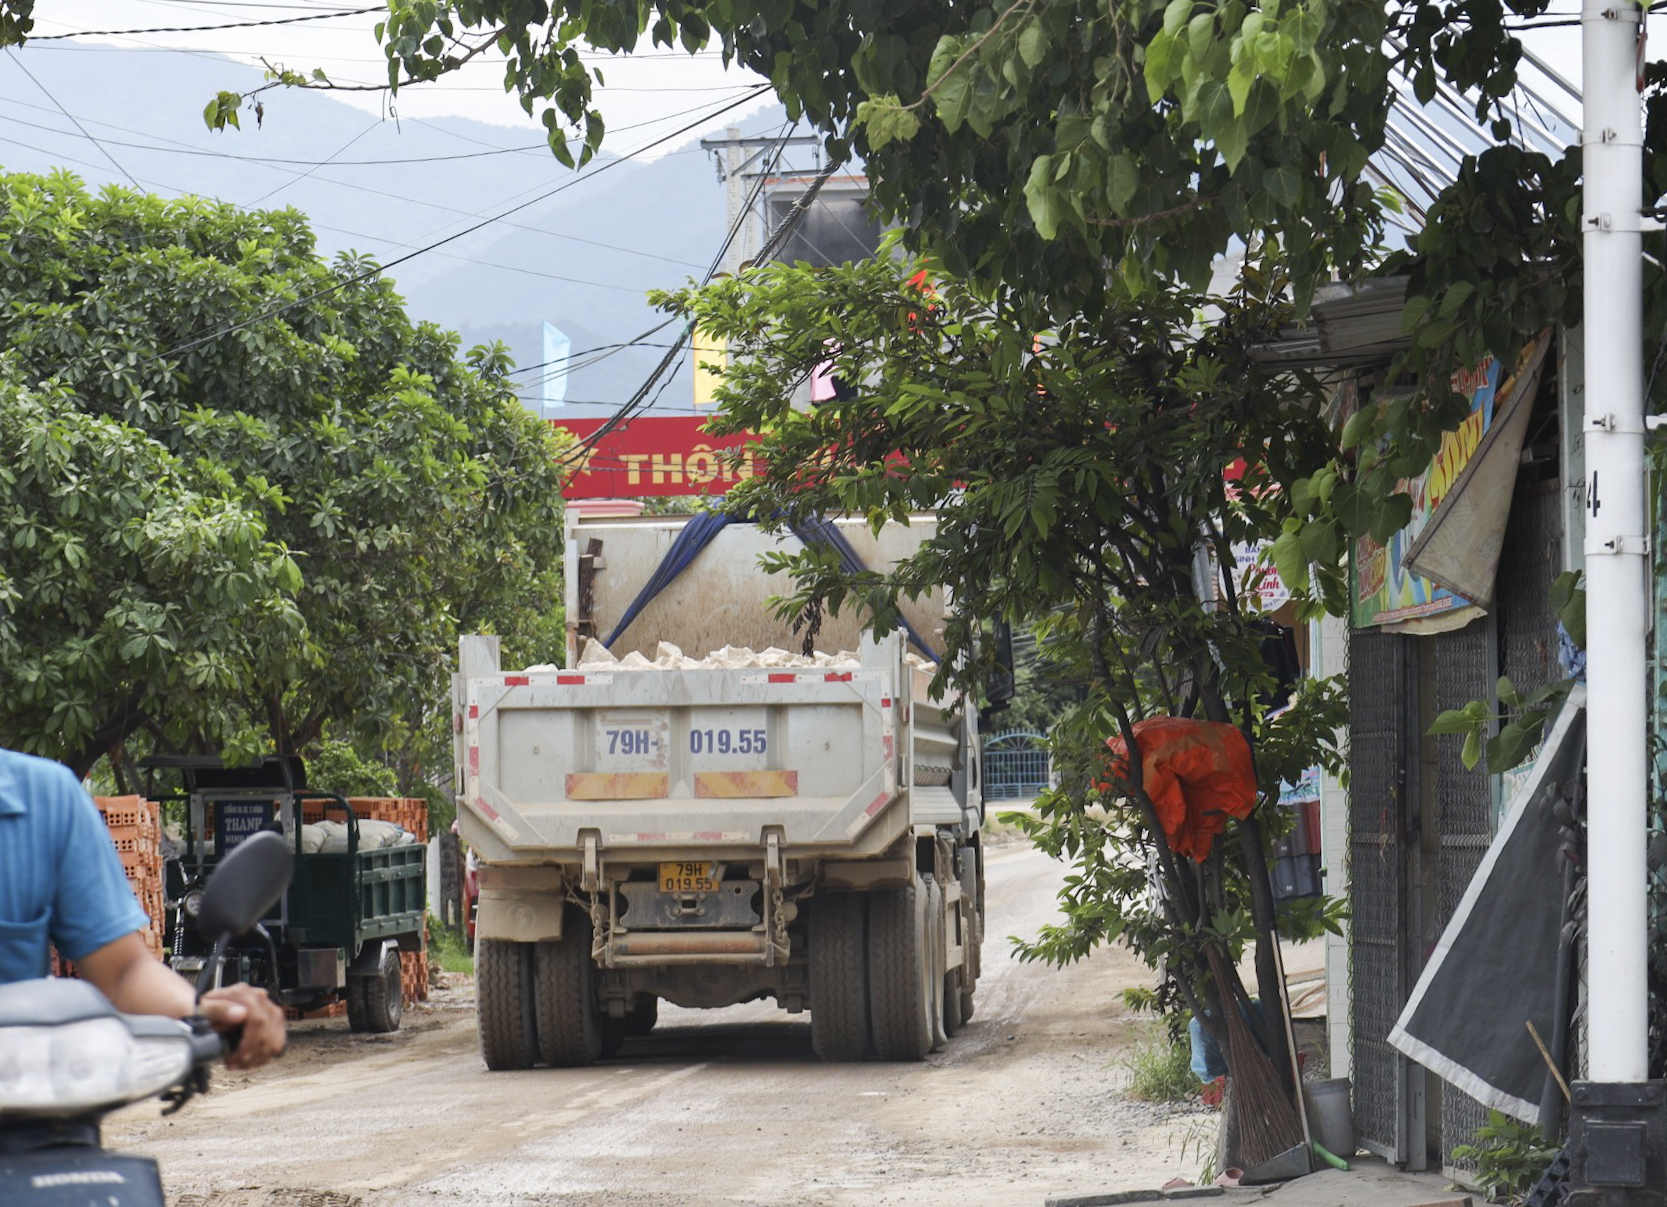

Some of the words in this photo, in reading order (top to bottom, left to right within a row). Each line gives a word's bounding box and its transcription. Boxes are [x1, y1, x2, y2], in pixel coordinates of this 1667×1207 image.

[606, 730, 659, 755] 79H-
[690, 729, 767, 754] 019.55
[675, 863, 703, 877] 79H
[666, 877, 713, 891] 019.55
